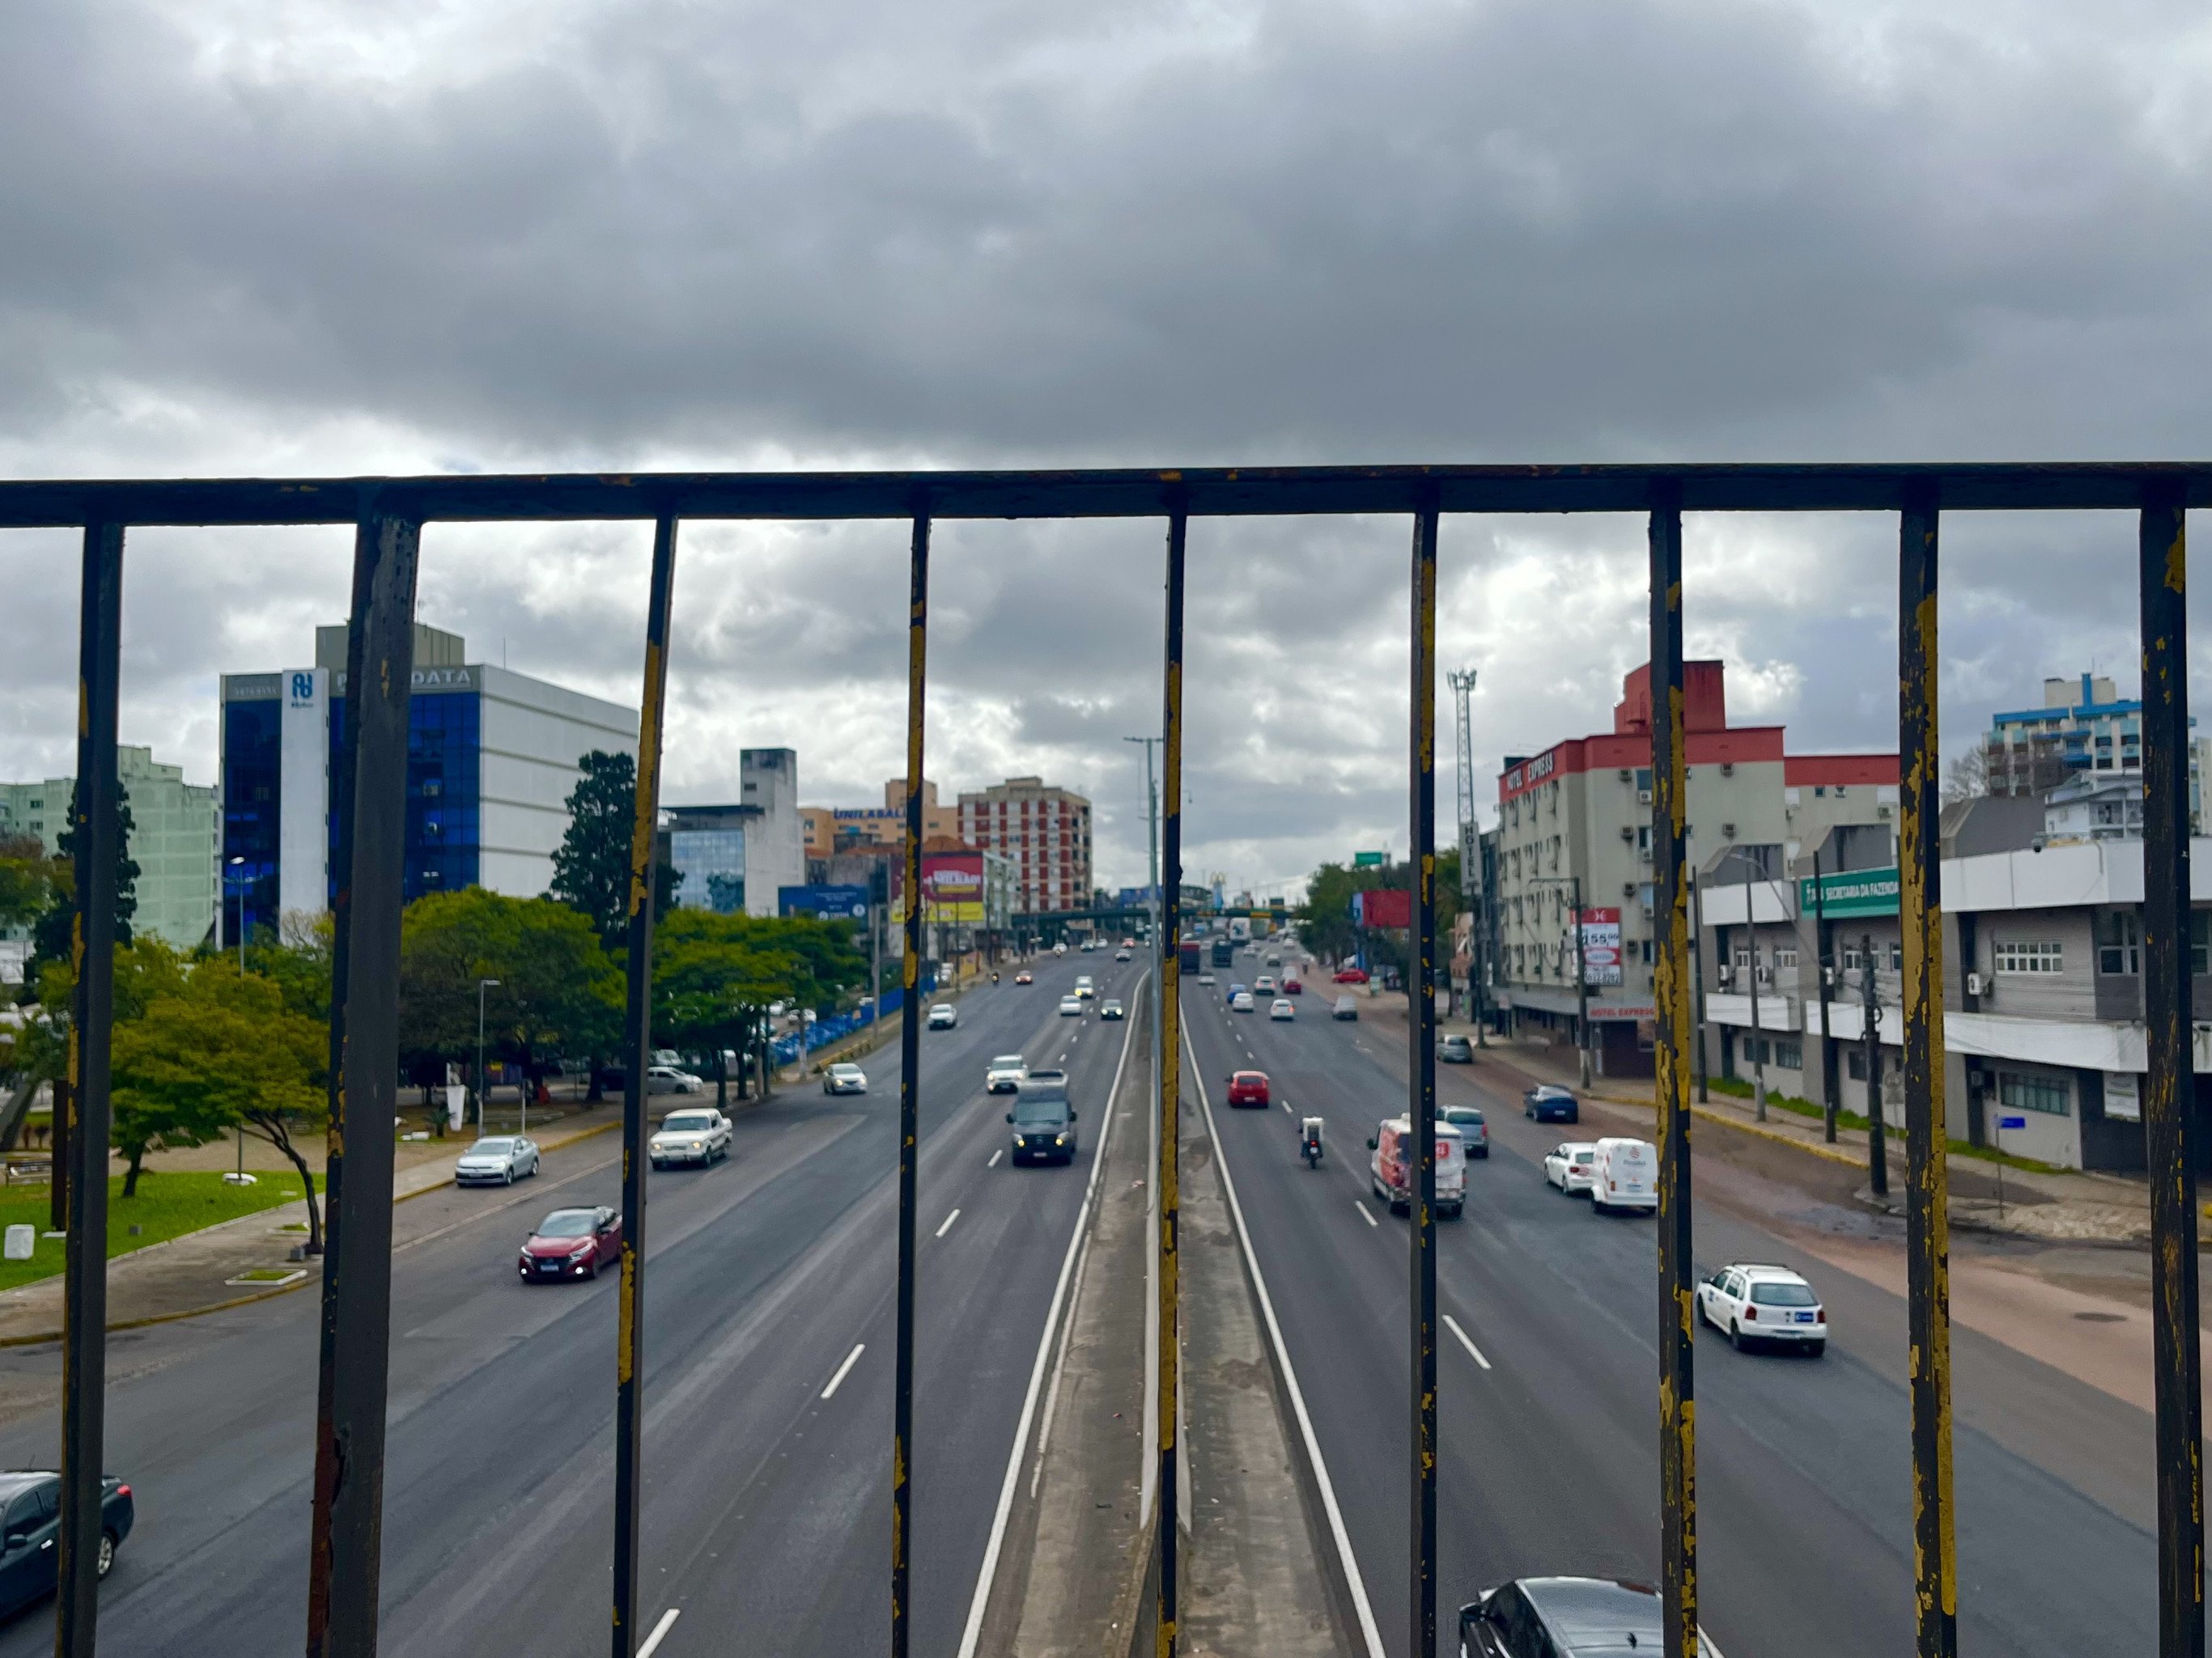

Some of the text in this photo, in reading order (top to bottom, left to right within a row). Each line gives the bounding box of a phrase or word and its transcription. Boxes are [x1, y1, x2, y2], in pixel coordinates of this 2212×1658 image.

[411, 669, 471, 685] DATA
[1528, 752, 1553, 782] EXPRESS
[1465, 826, 1474, 877] HOTEL
[1826, 884, 1860, 901] SECRETARIA
[1861, 883, 1870, 897] DA
